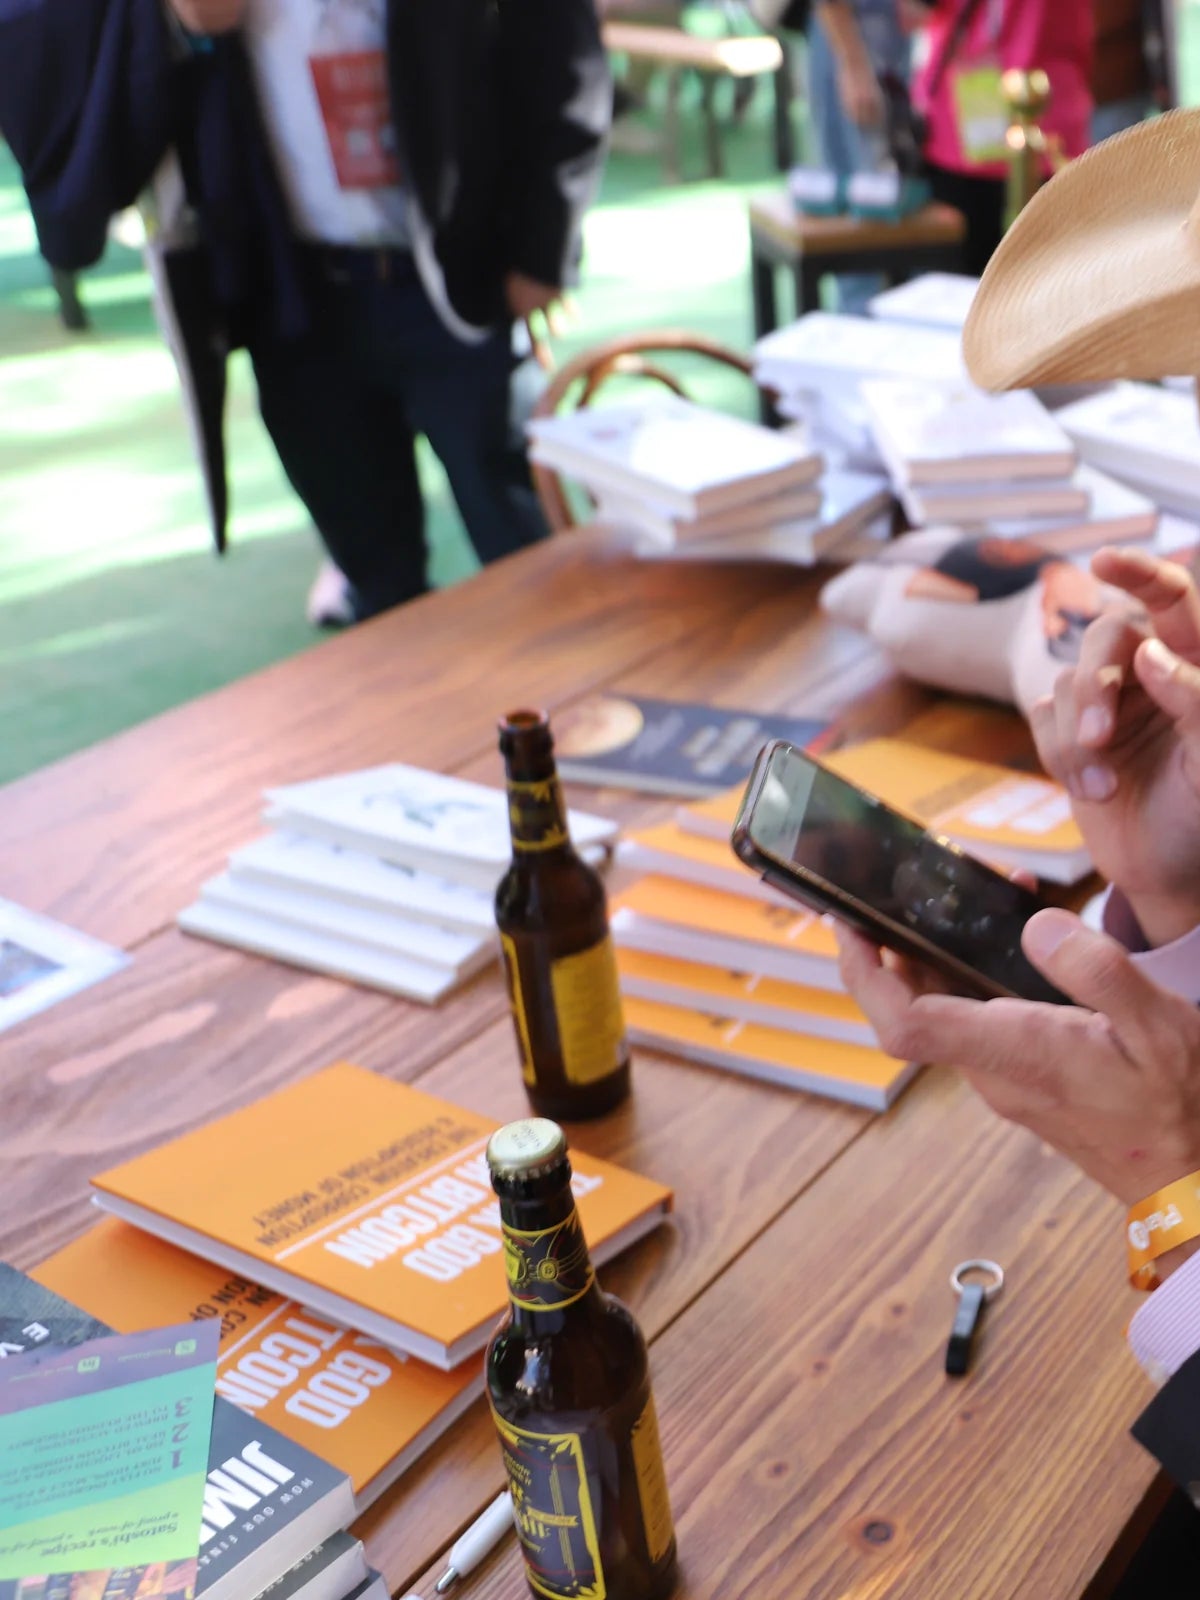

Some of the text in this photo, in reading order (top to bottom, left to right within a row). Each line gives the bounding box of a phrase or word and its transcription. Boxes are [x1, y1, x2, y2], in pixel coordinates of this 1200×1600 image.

[252, 1190, 318, 1228] MONEY
[256, 1184, 371, 1246] CORRUPTION
[324, 1167, 489, 1269] BITCOIN
[402, 1221, 503, 1283] GOD
[174, 1397, 193, 1418] 3
[284, 1349, 392, 1430] GOD
[171, 1422, 190, 1443] 2
[171, 1448, 185, 1470] 1
[197, 1440, 295, 1546] JIM
[40, 1521, 179, 1557] Satoshi's recipe
[196, 1478, 314, 1571] HOW OUR FINA
